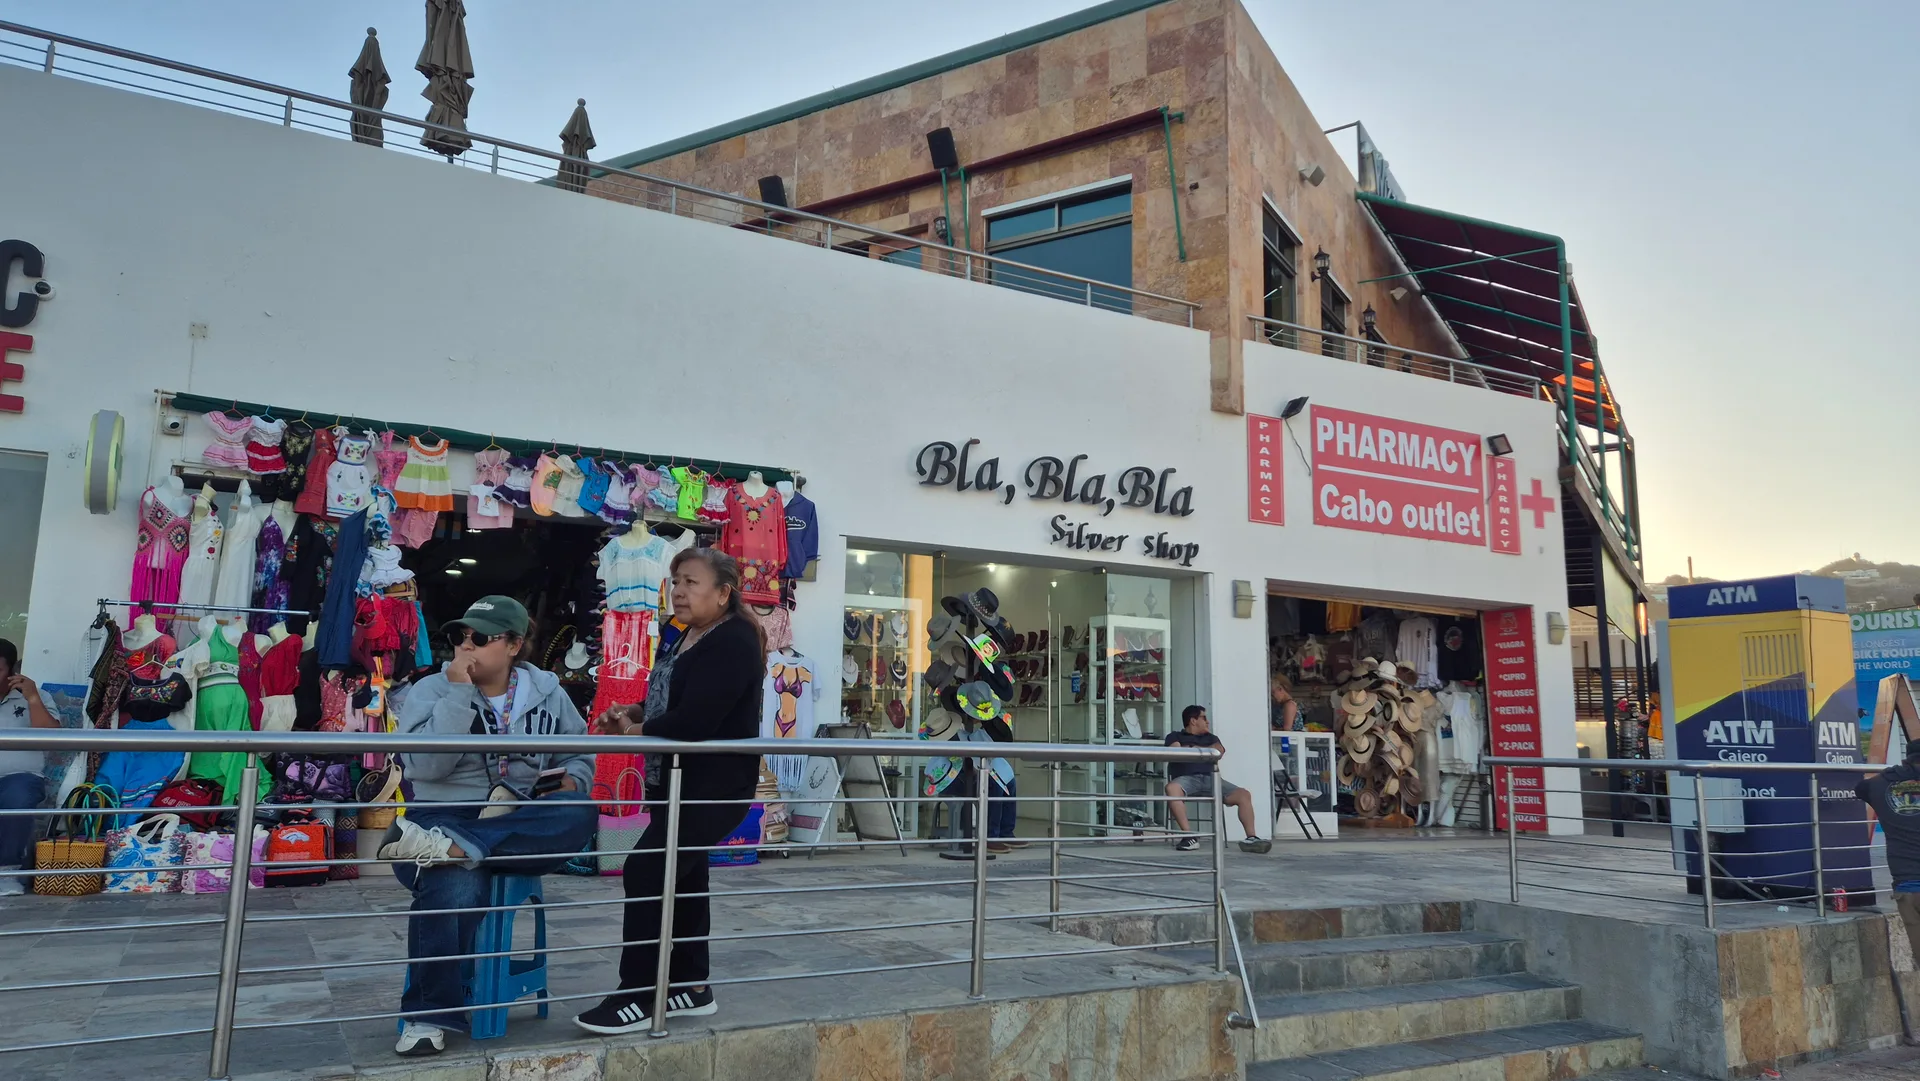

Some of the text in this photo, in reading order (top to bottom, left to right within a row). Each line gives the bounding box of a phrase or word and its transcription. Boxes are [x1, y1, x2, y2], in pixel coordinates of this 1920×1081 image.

[1316, 416, 1477, 477] PHARMACY
[916, 437, 1195, 517] Bla, Bla, Bla
[1258, 421, 1273, 518] PHARMACY
[1320, 483, 1481, 538] Cabo outlet
[1496, 461, 1510, 549] PHARMACY
[1050, 514, 1129, 552] Silver
[1706, 584, 1758, 606] ATM
[1850, 610, 1920, 632] OURIST
[1854, 649, 1880, 659] BIKE
[1861, 639, 1906, 648] LONGEST
[1873, 660, 1910, 670] WORLD
[1706, 720, 1775, 745] ATM
[1818, 721, 1857, 747] ATM
[1820, 786, 1858, 801] Eurone
